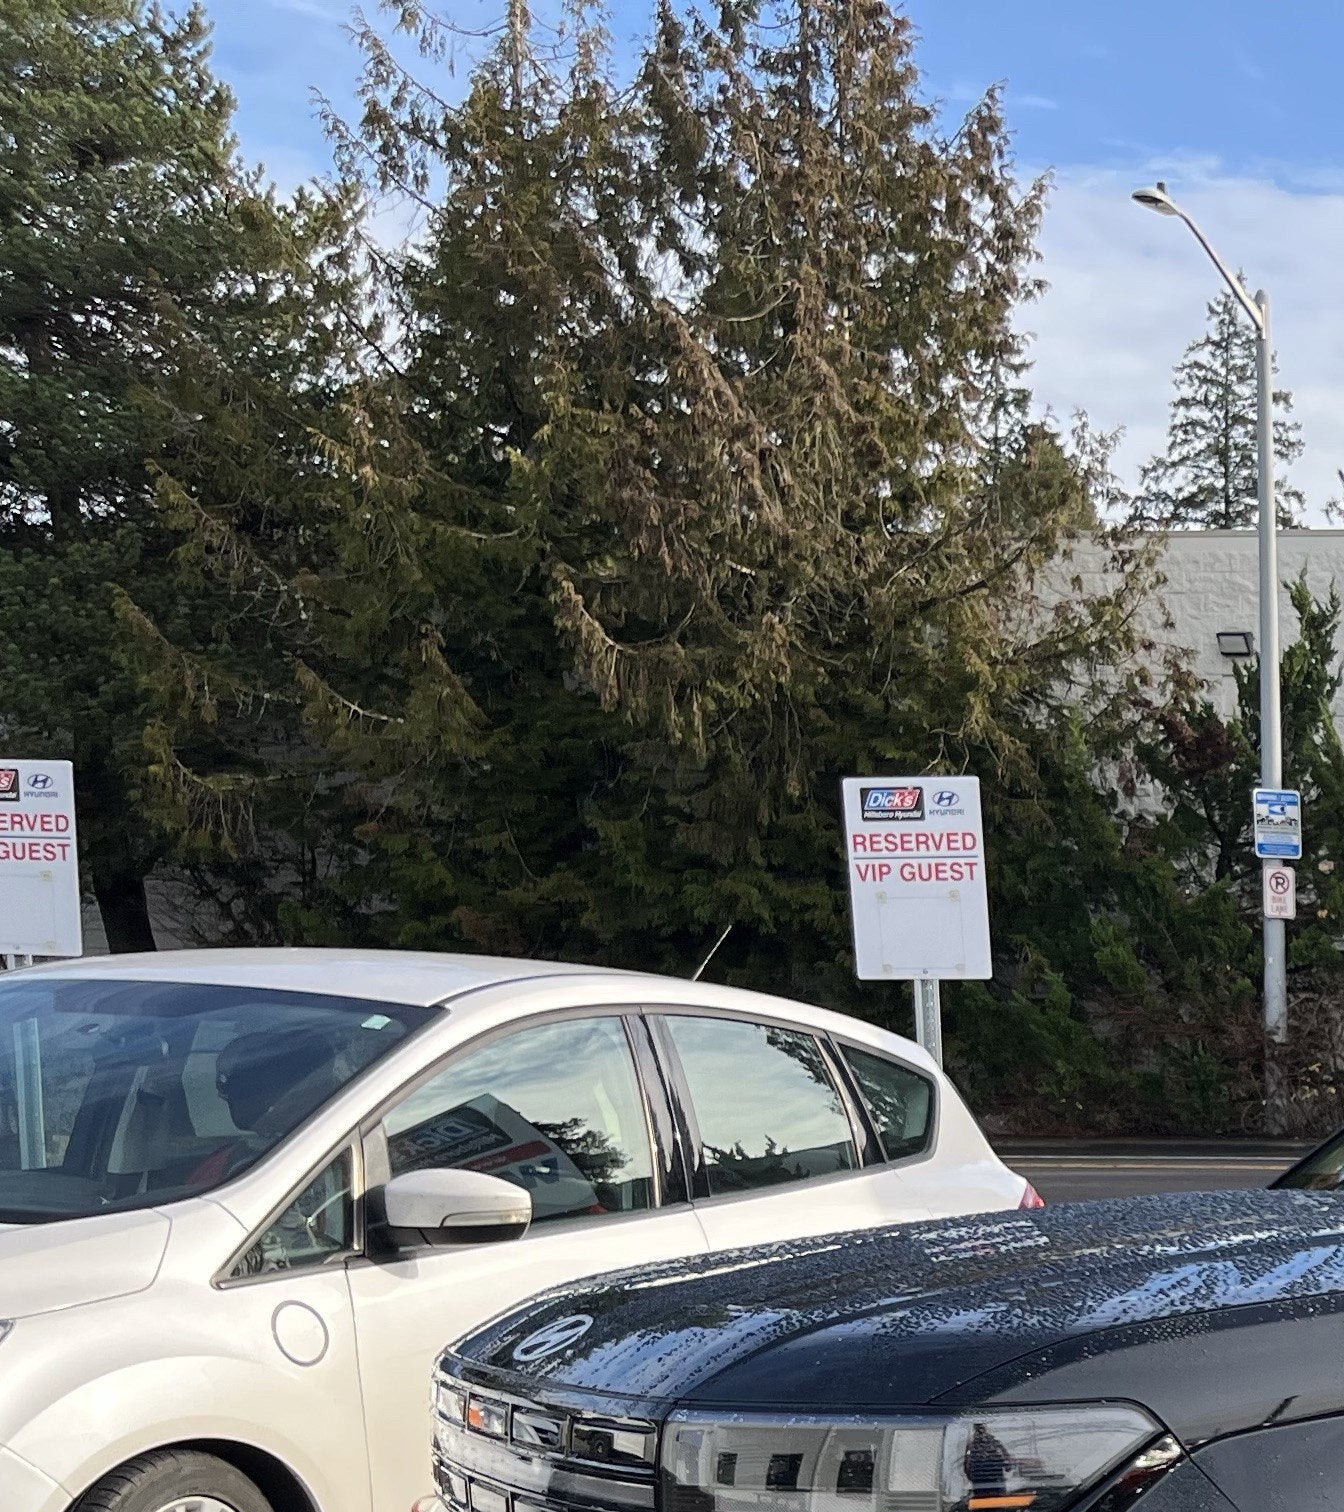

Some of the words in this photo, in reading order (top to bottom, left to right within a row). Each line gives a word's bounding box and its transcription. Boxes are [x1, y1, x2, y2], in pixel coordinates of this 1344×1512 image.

[852, 832, 978, 853] RESERVED
[855, 863, 892, 883] VIP
[899, 862, 978, 882] GUEST
